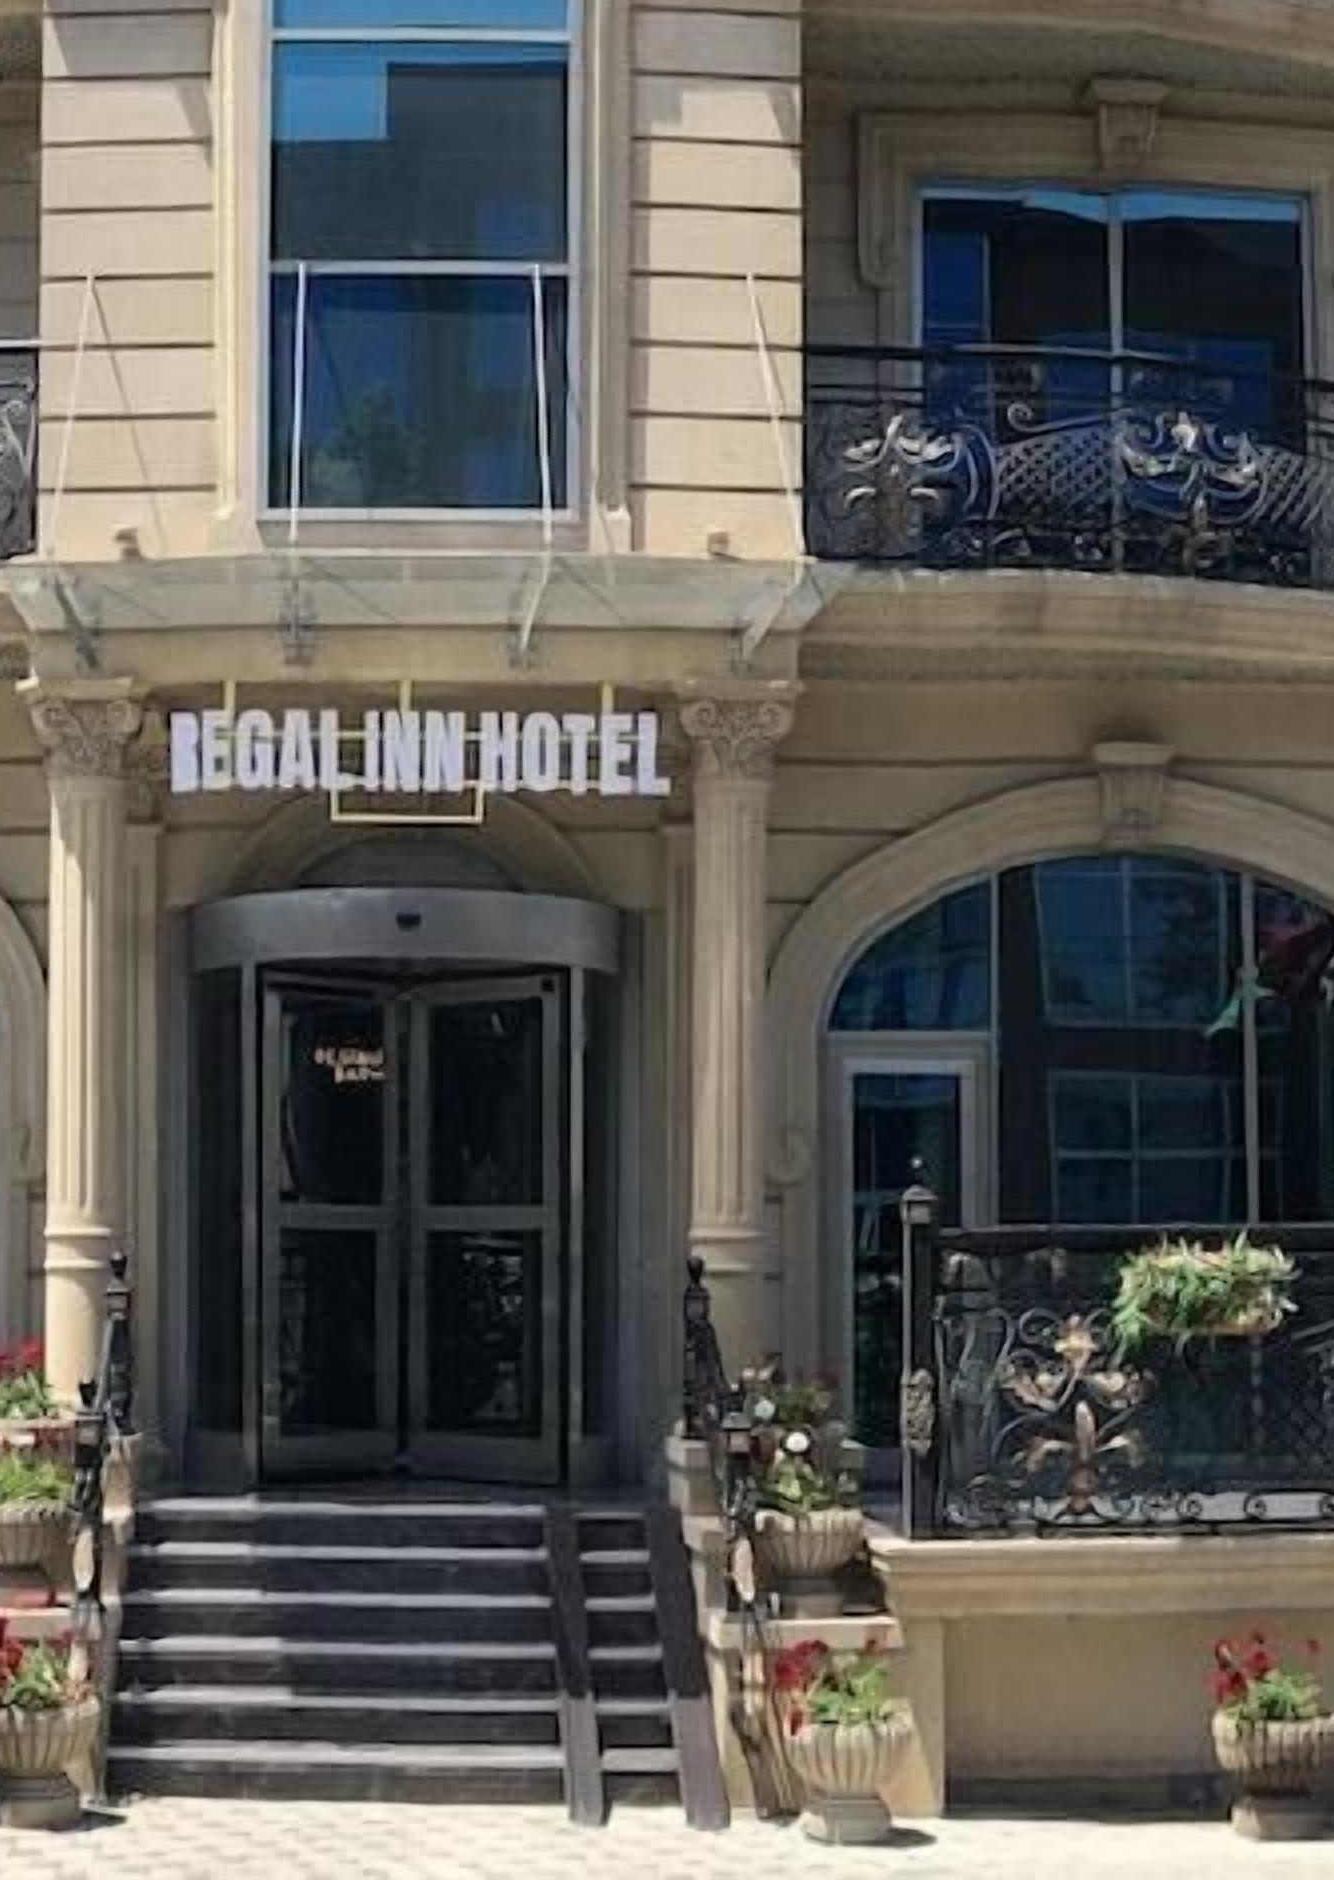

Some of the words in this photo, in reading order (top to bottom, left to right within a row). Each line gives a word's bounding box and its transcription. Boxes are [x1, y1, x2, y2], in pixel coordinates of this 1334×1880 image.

[170, 708, 361, 793] REGAL
[364, 709, 466, 793] INN
[479, 711, 671, 796] HOTEL
